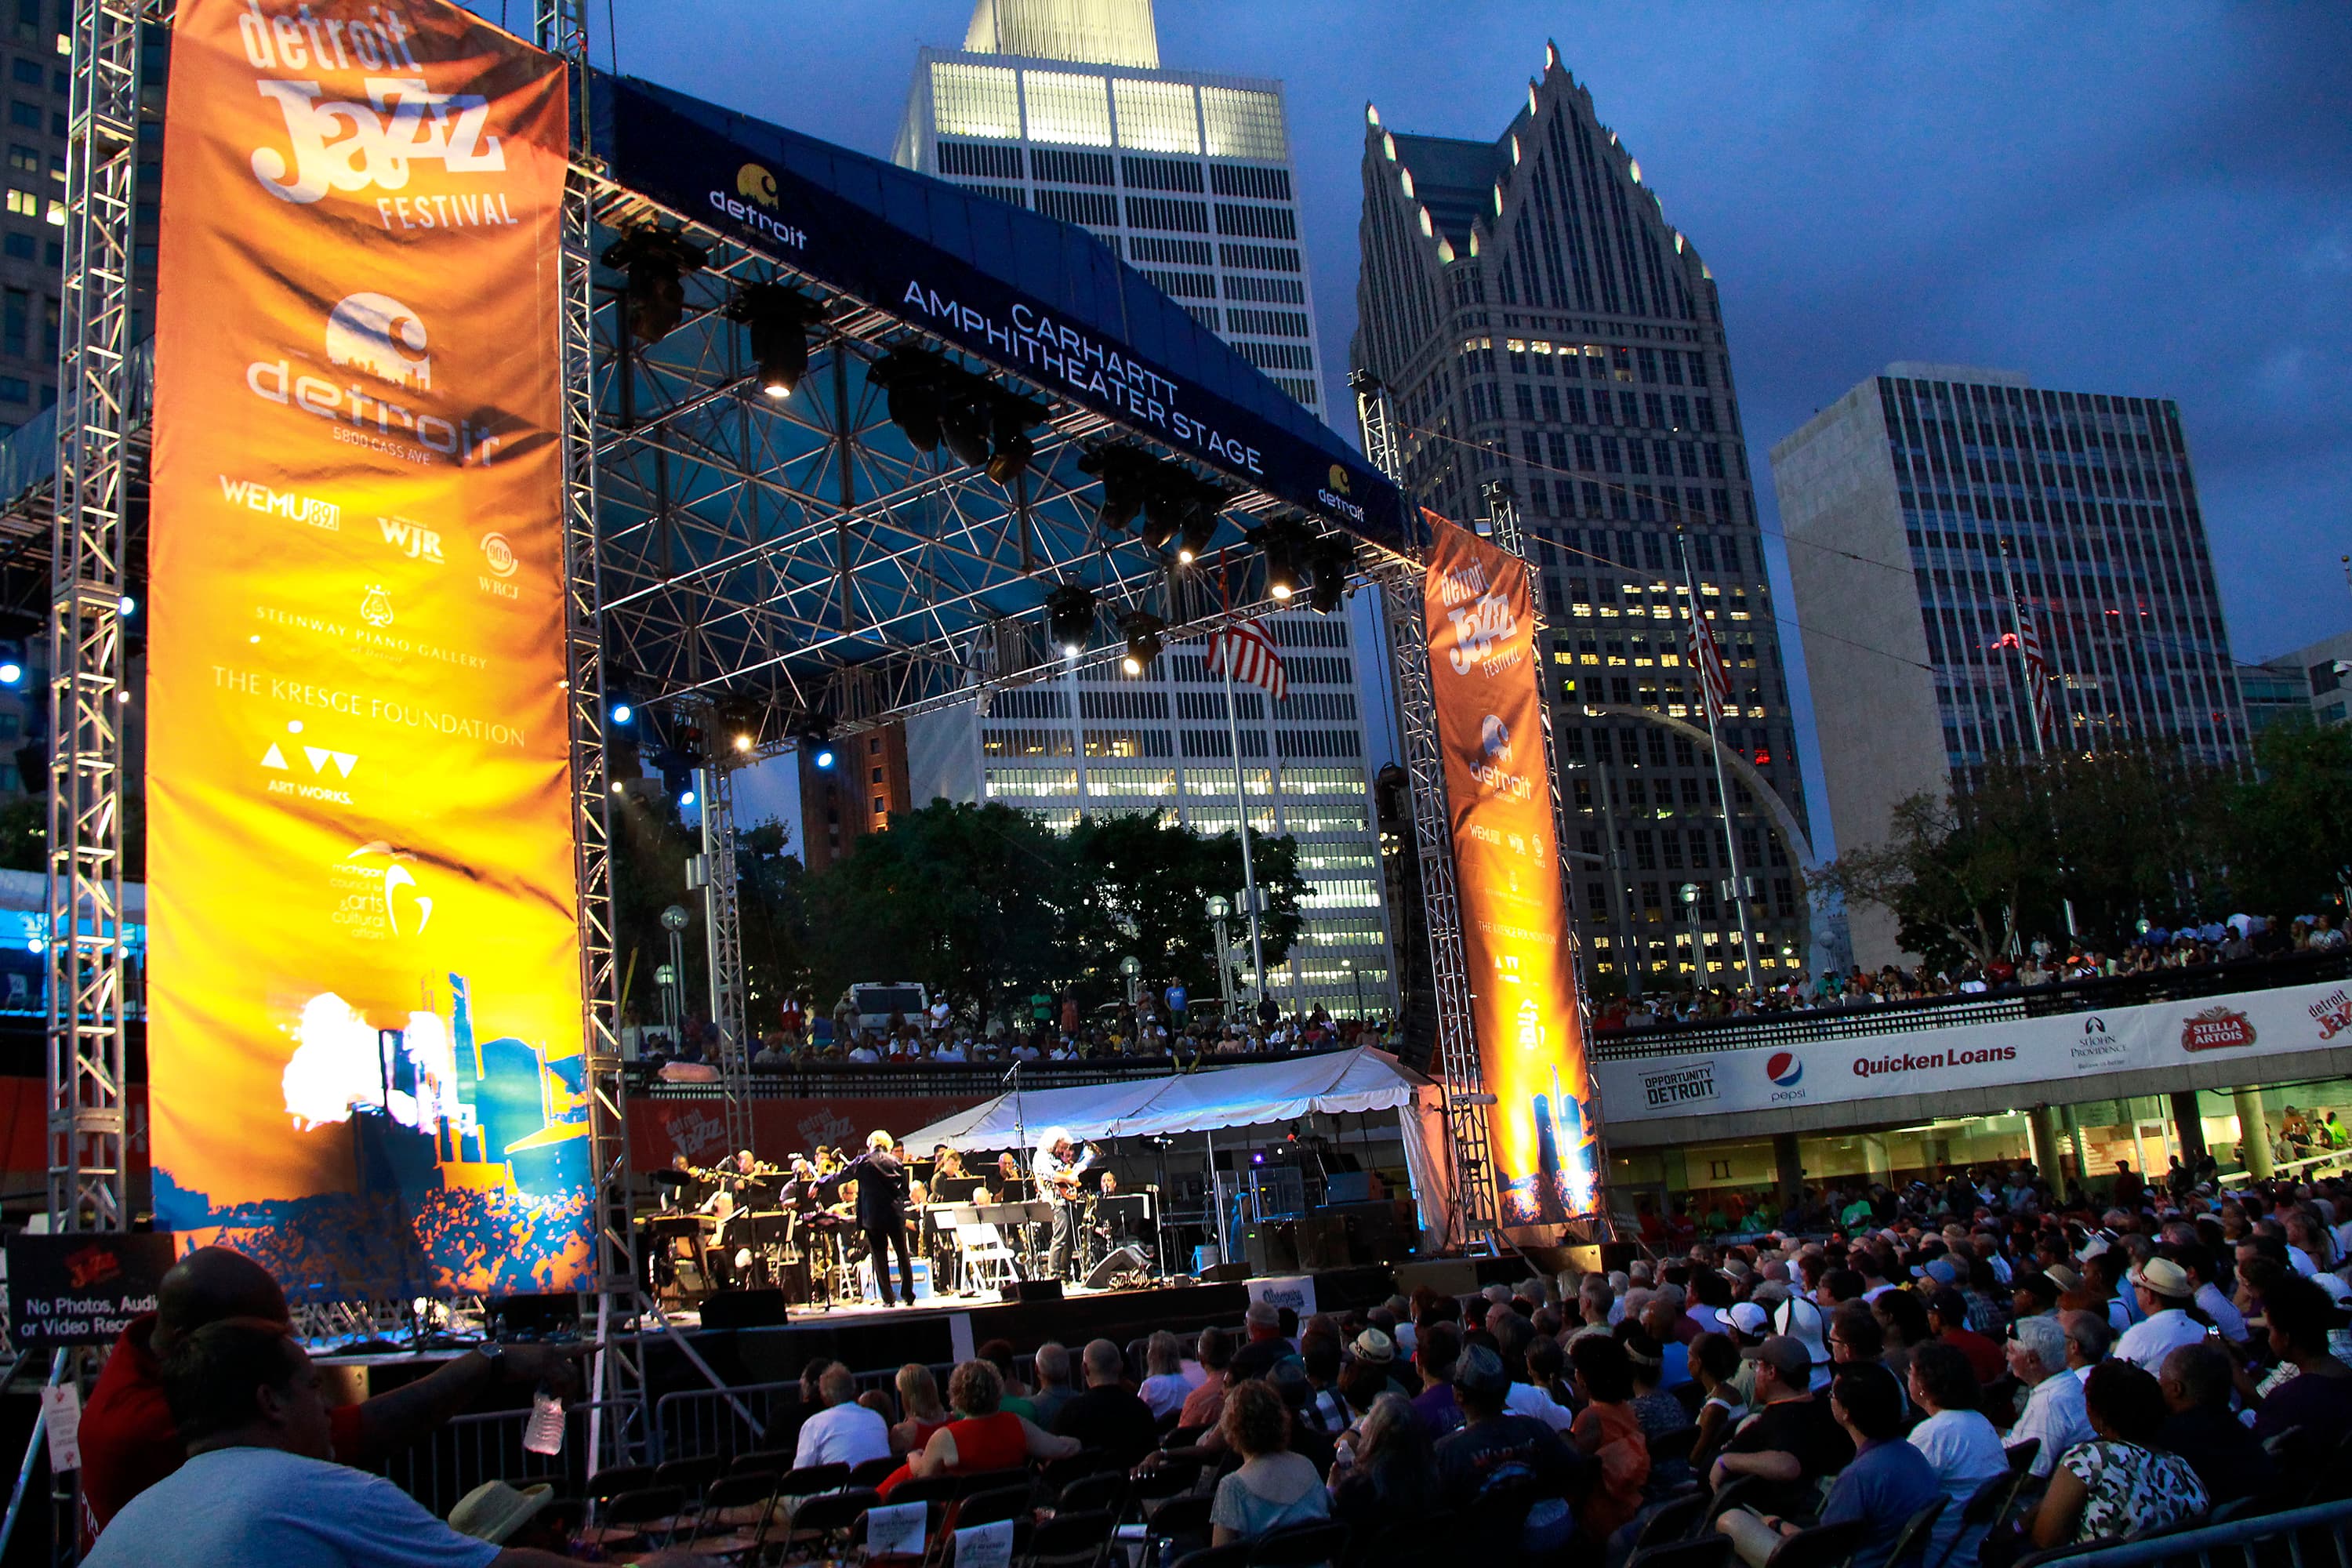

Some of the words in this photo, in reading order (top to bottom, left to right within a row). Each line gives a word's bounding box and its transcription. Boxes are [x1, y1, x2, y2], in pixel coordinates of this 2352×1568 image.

[238, 0, 423, 73] detroit
[377, 192, 517, 230] FESTIVAL
[710, 191, 807, 249] detroit
[1011, 303, 1178, 407] CARHARTT
[903, 280, 1167, 429] AMPHITHEATER
[1172, 412, 1264, 475] STAGE
[245, 358, 500, 467] detroit
[333, 426, 368, 448] 5800
[371, 437, 405, 459] CASS
[407, 448, 430, 466] AVE
[220, 474, 309, 521] WEMU
[1318, 488, 1364, 522] detroit
[376, 516, 444, 558] WJR
[477, 575, 519, 600] WRCJ
[1441, 557, 1490, 607] detroit
[256, 604, 347, 637] STEINWAY
[356, 628, 410, 652] PIANO
[418, 644, 487, 670] GALLERY
[1483, 645, 1521, 679] FESTIVAL
[212, 665, 261, 695] THE
[272, 678, 361, 716] KRESGE
[372, 699, 525, 748] FOUNDATION
[267, 779, 295, 795] ART
[1469, 759, 1531, 800] detroit
[1469, 823, 1493, 843] WEMU
[332, 862, 385, 879] michigan
[1478, 920, 1492, 935] THE
[2308, 989, 2350, 1018] detroit
[2193, 1019, 2241, 1035] STELLA
[2194, 1029, 2244, 1045] ARTOIS
[1644, 1067, 1711, 1088] OPPORTUNITY
[1853, 1052, 1944, 1078] Quicken
[1947, 1044, 2016, 1066] Loans
[1646, 1078, 1715, 1105] DETROIT
[1771, 1088, 1806, 1102] pepsi
[26, 1298, 50, 1316] No
[55, 1296, 116, 1315] Photos,
[120, 1294, 158, 1312] Audi
[21, 1322, 38, 1337] or
[42, 1318, 89, 1335] Video
